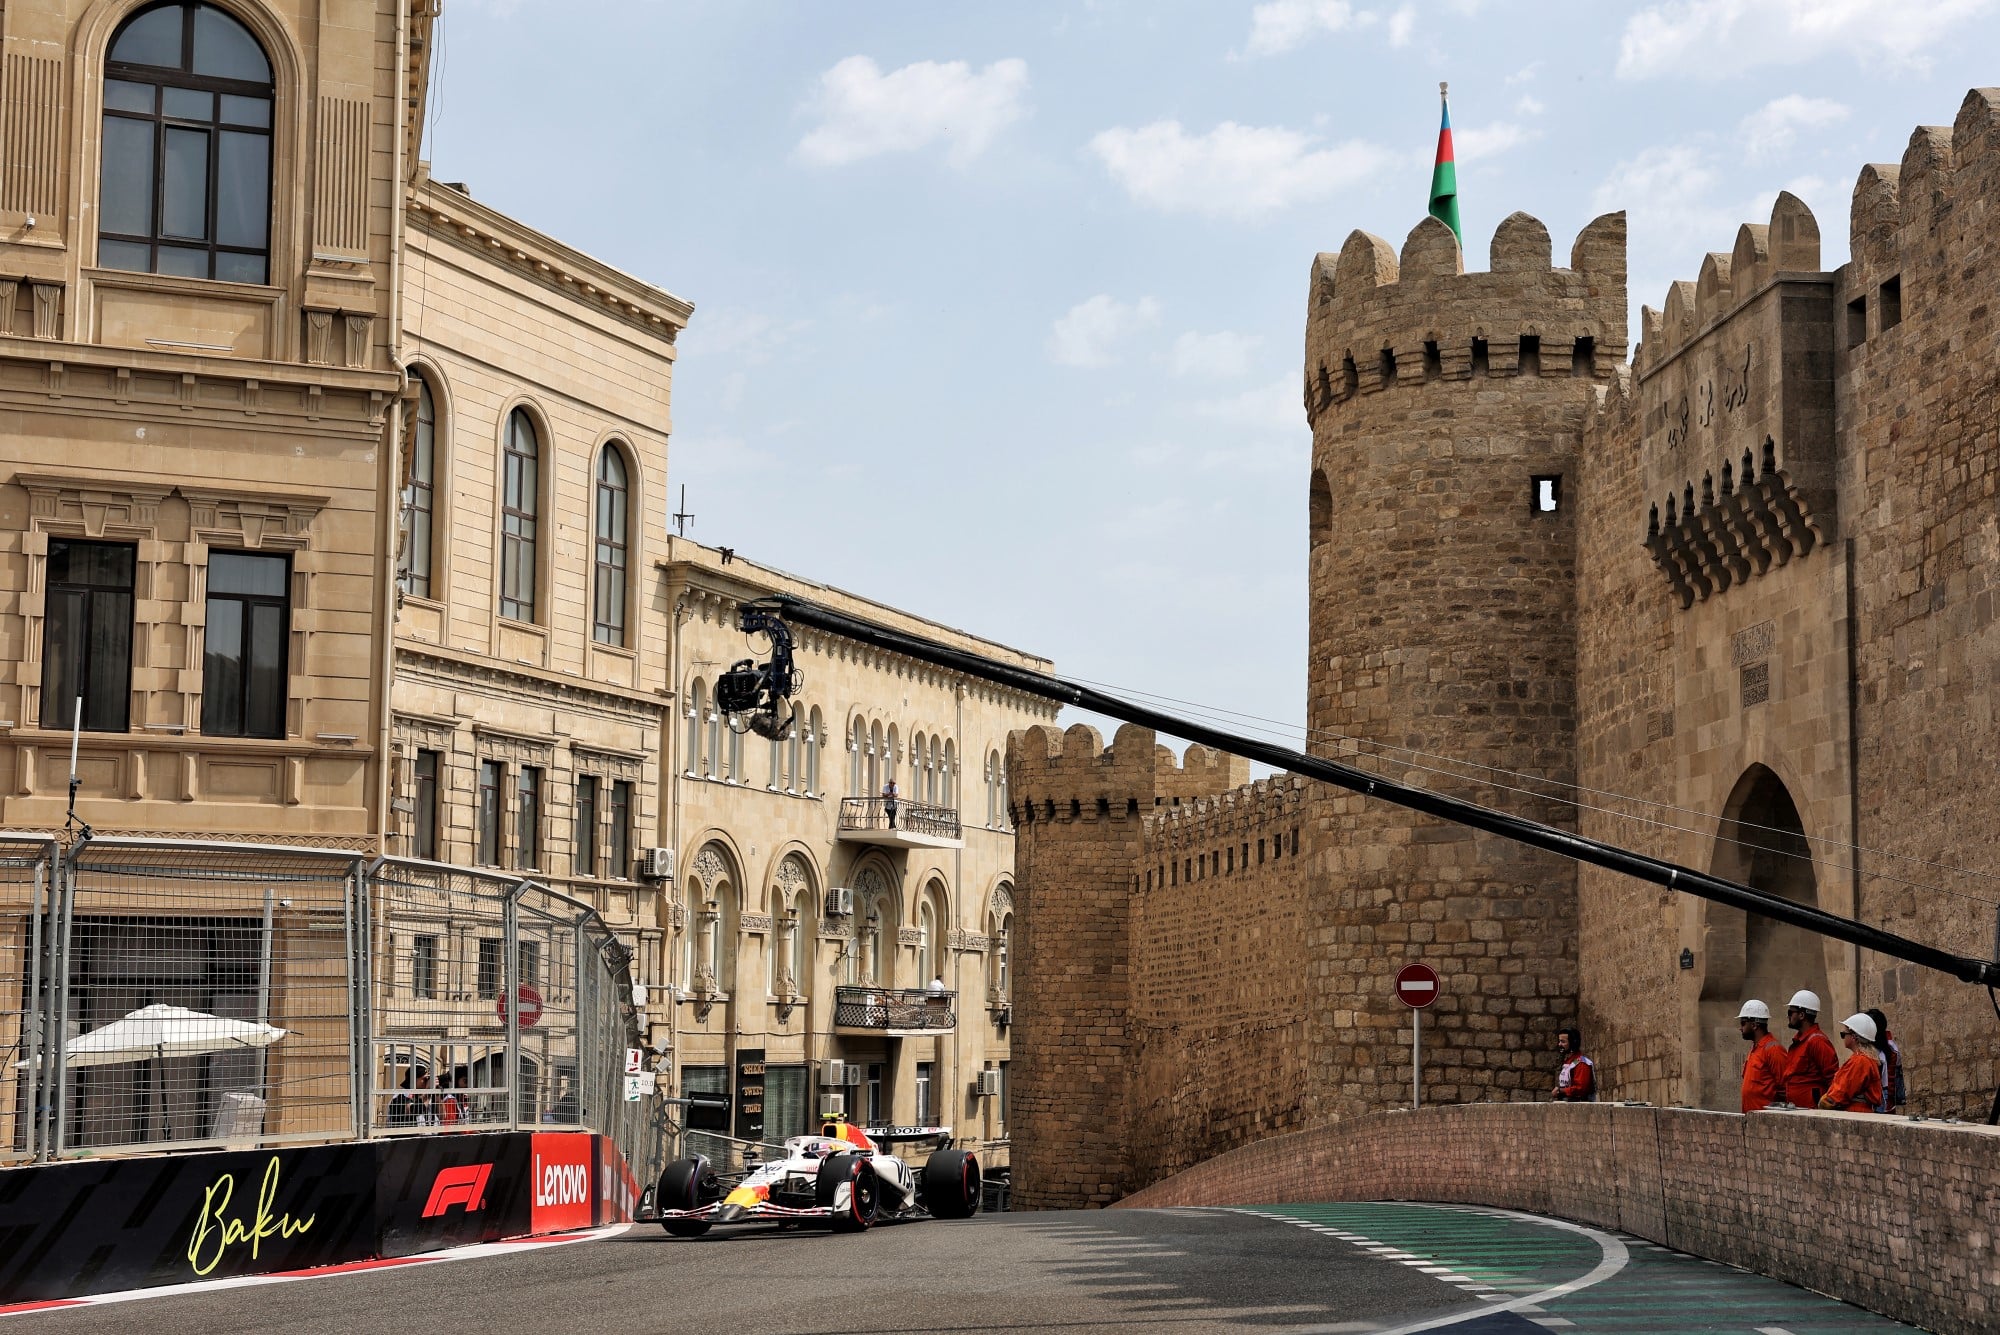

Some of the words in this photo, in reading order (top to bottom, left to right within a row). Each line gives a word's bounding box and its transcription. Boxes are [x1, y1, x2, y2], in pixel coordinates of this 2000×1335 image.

[421, 1163, 493, 1218] F1
[536, 1153, 587, 1207] Lenovo
[188, 1156, 316, 1276] Baku
